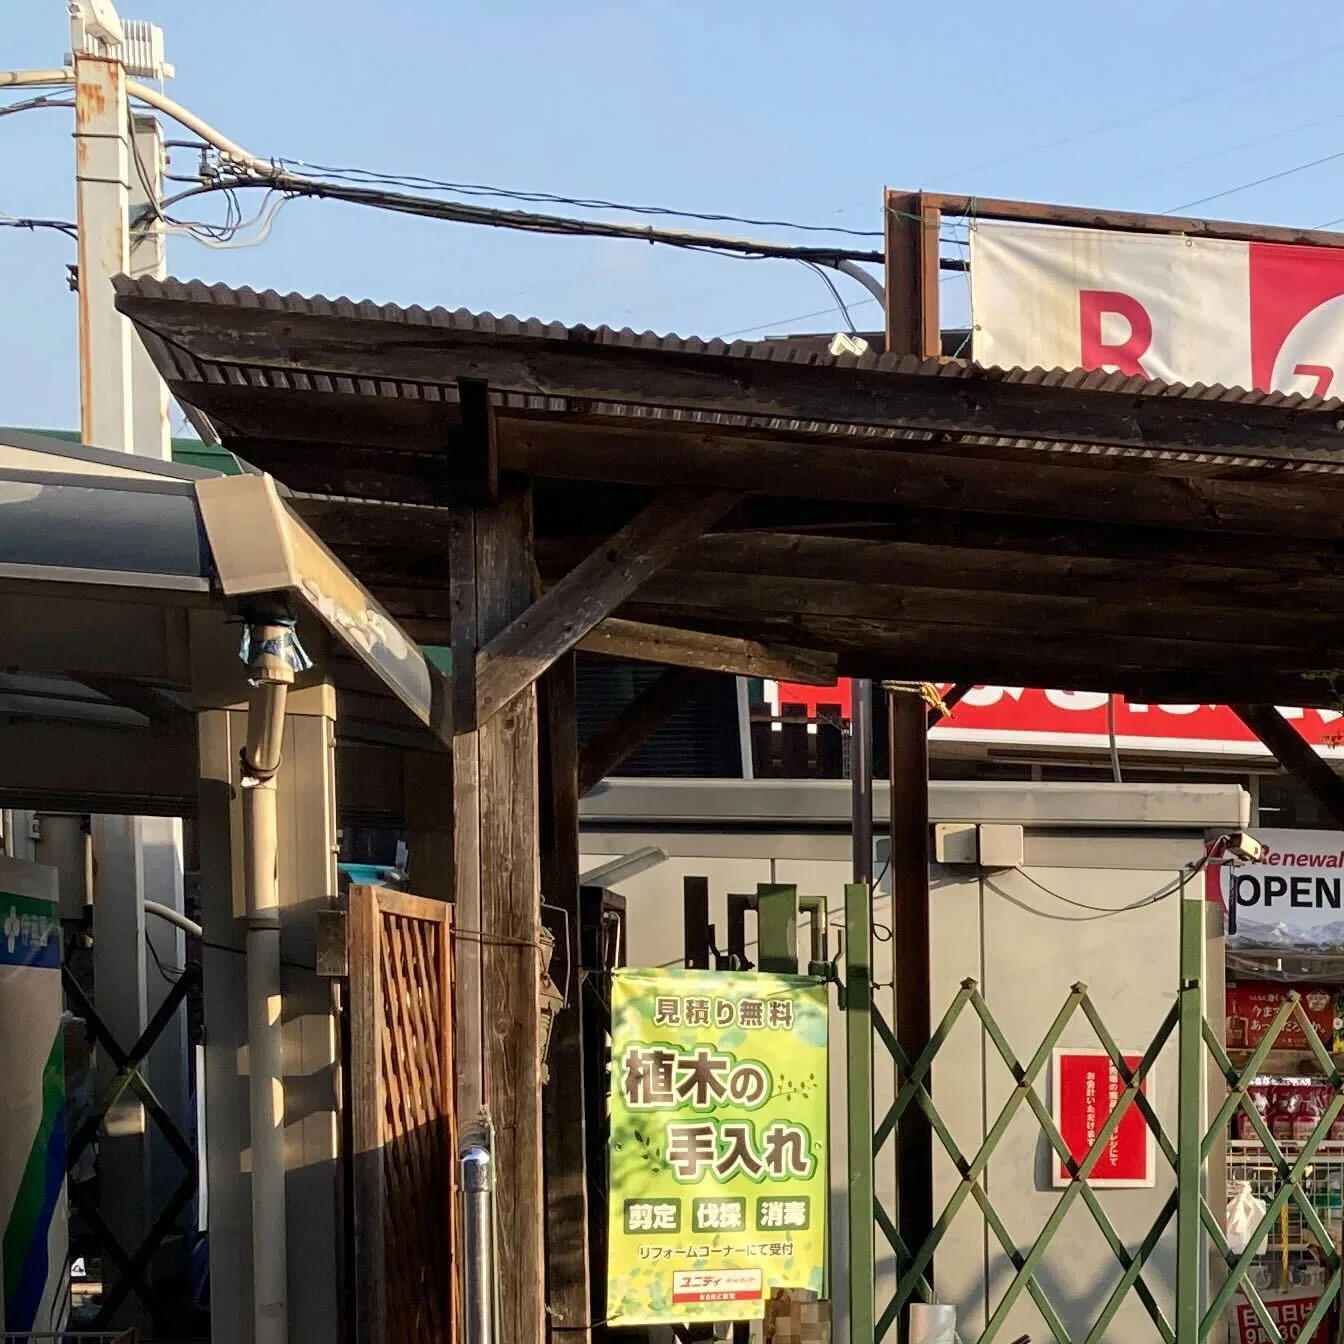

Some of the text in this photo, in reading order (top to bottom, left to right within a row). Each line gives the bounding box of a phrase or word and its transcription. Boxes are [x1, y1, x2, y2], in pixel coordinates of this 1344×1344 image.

[1080, 290, 1152, 380] R
[655, 998, 794, 1028] 見積り無料
[624, 1048, 766, 1106] 植木の
[667, 1125, 810, 1177] 手入れ
[628, 1200, 806, 1230] 剪定 伐採 消毒
[639, 1242, 794, 1260] リフォームコーナーにて受付
[679, 1276, 723, 1288] ユニディ
